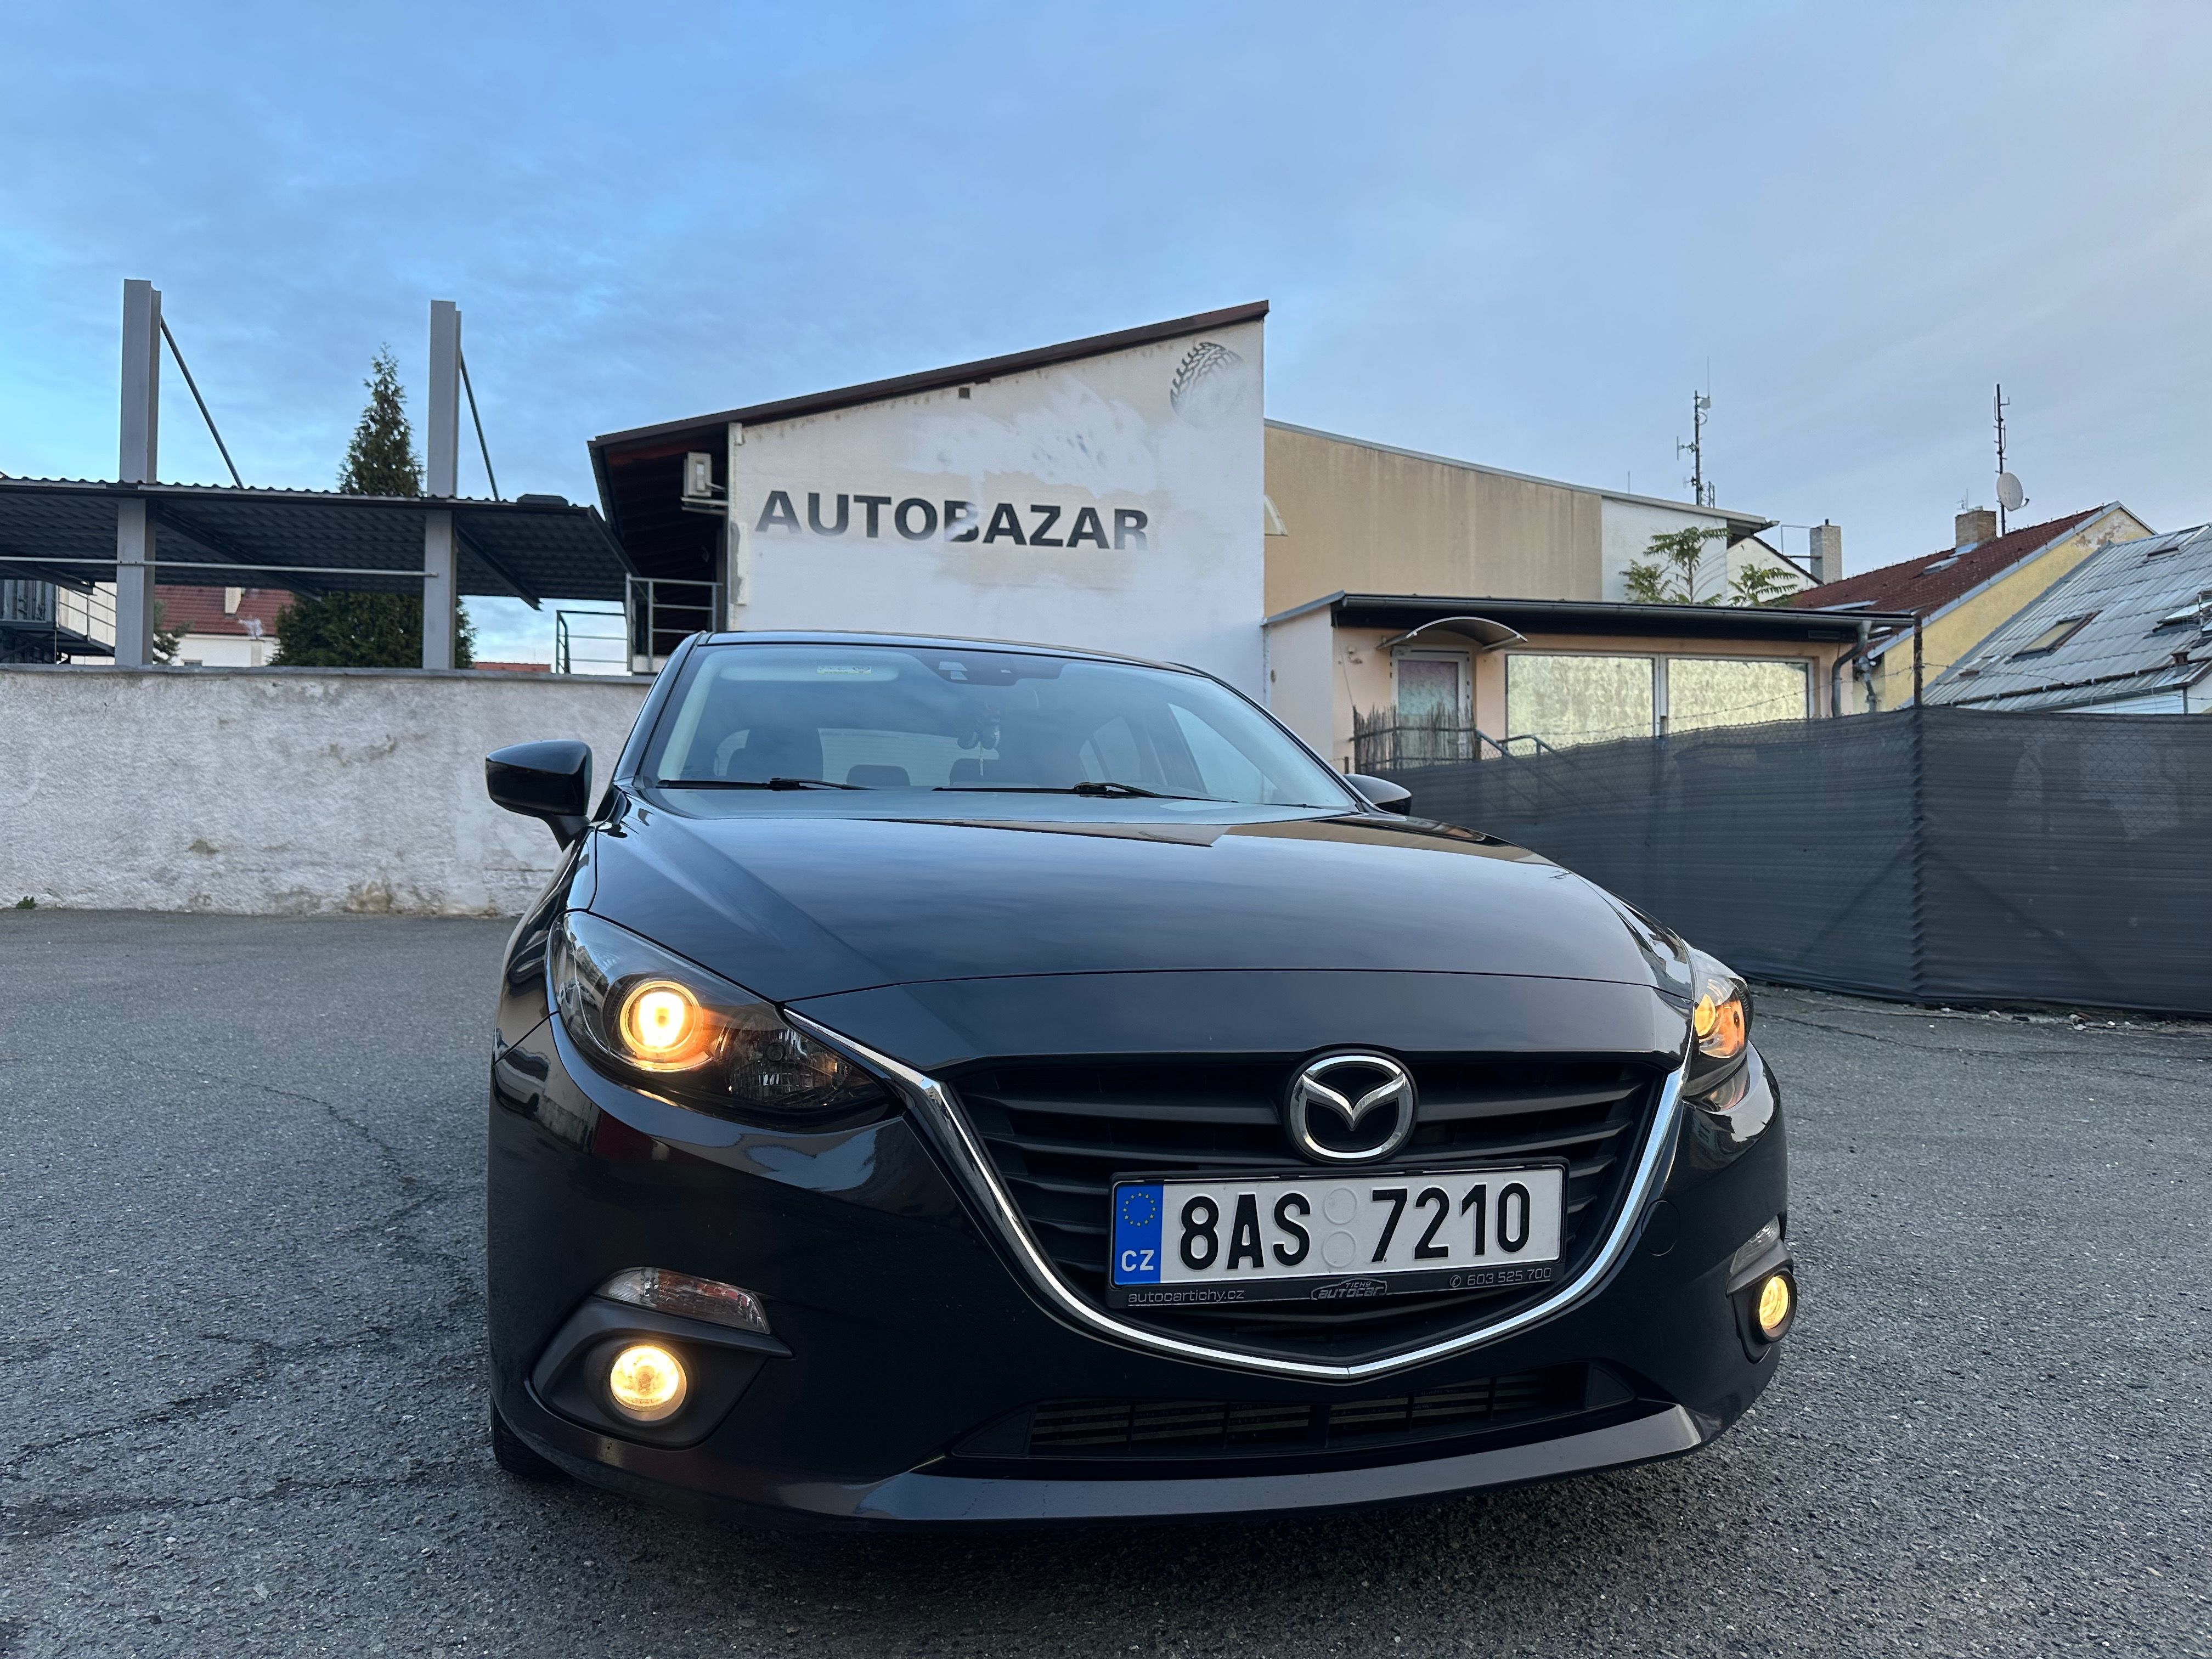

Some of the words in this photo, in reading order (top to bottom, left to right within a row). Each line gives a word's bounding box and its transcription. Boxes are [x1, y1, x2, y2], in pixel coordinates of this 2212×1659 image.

[755, 490, 1149, 549] AUTOBAZAR
[1180, 1193, 1311, 1271] 8AS
[1370, 1182, 1531, 1263] 7210
[1121, 1249, 1154, 1272] CZ
[1467, 1273, 1494, 1286] 603
[1497, 1270, 1523, 1283] 525
[1527, 1267, 1551, 1280] 700
[1128, 1289, 1245, 1303] autocartichy.cz
